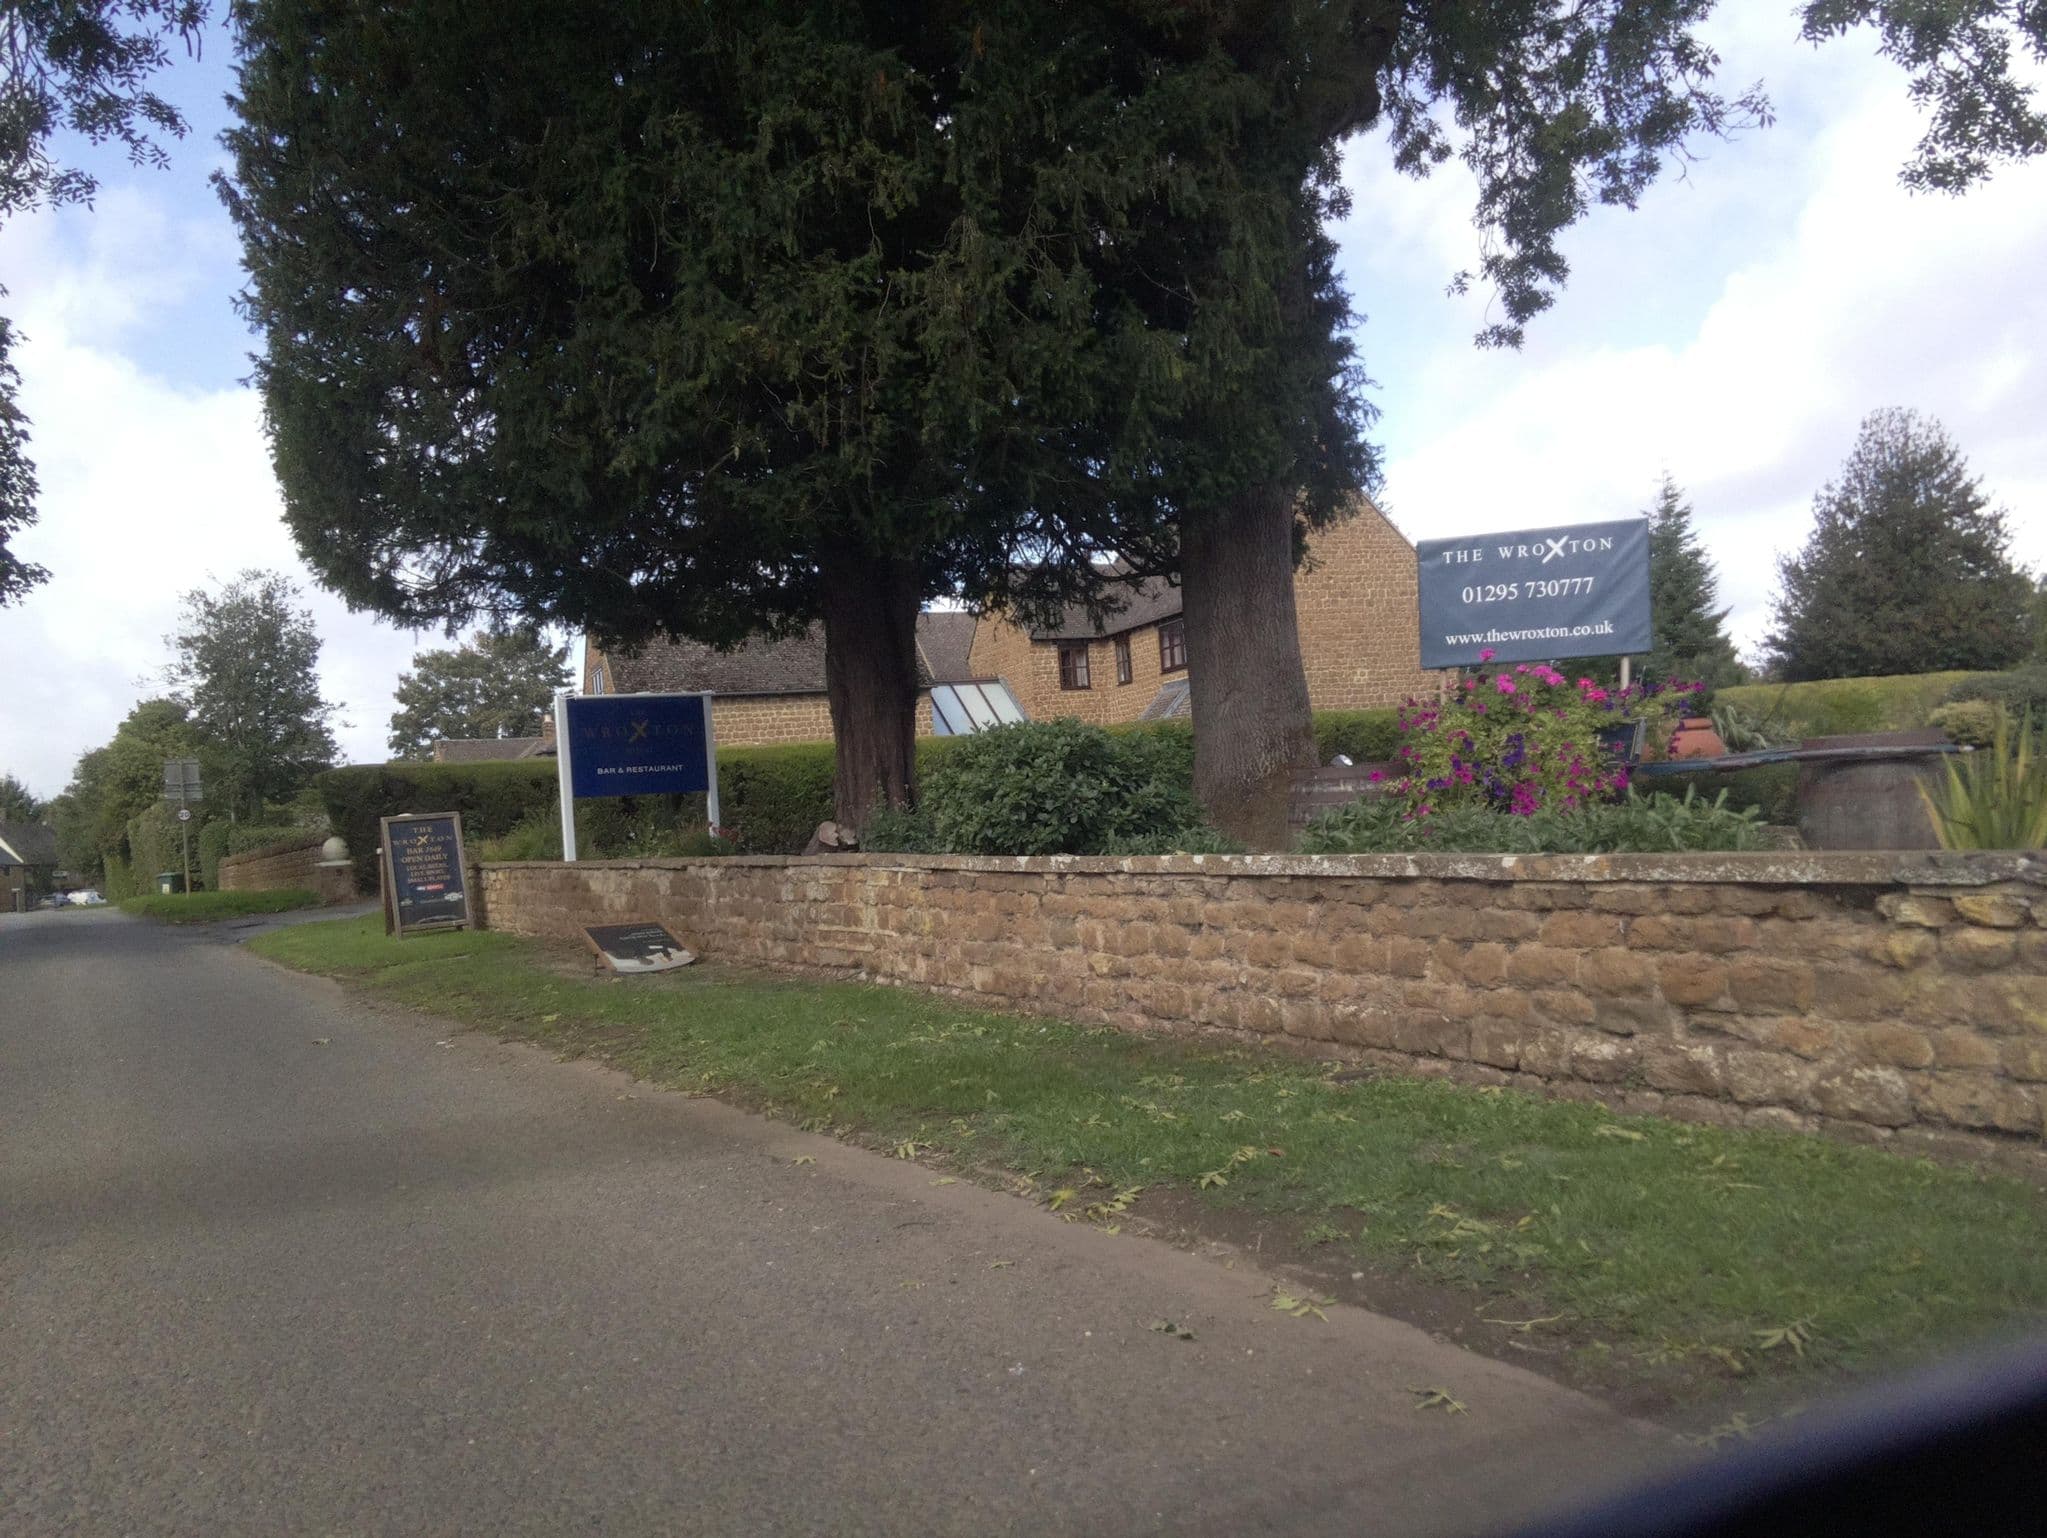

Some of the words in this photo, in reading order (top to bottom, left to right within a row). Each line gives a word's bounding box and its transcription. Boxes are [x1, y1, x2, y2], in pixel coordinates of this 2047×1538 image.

[1442, 548, 1483, 564] THE
[1498, 535, 1614, 564] WROXTON
[1462, 583, 1519, 604] 01295
[1525, 576, 1595, 599] 730777
[1445, 620, 1614, 646] www.thewroxton.co.uk
[584, 718, 694, 744] WROXTON
[597, 767, 616, 776] BAR
[617, 766, 624, 774] &
[626, 764, 684, 774] RESTAURANT
[413, 826, 433, 834] THE
[392, 834, 454, 846] WROXTON
[401, 855, 423, 864] OPEN
[424, 853, 448, 862] DAILY
